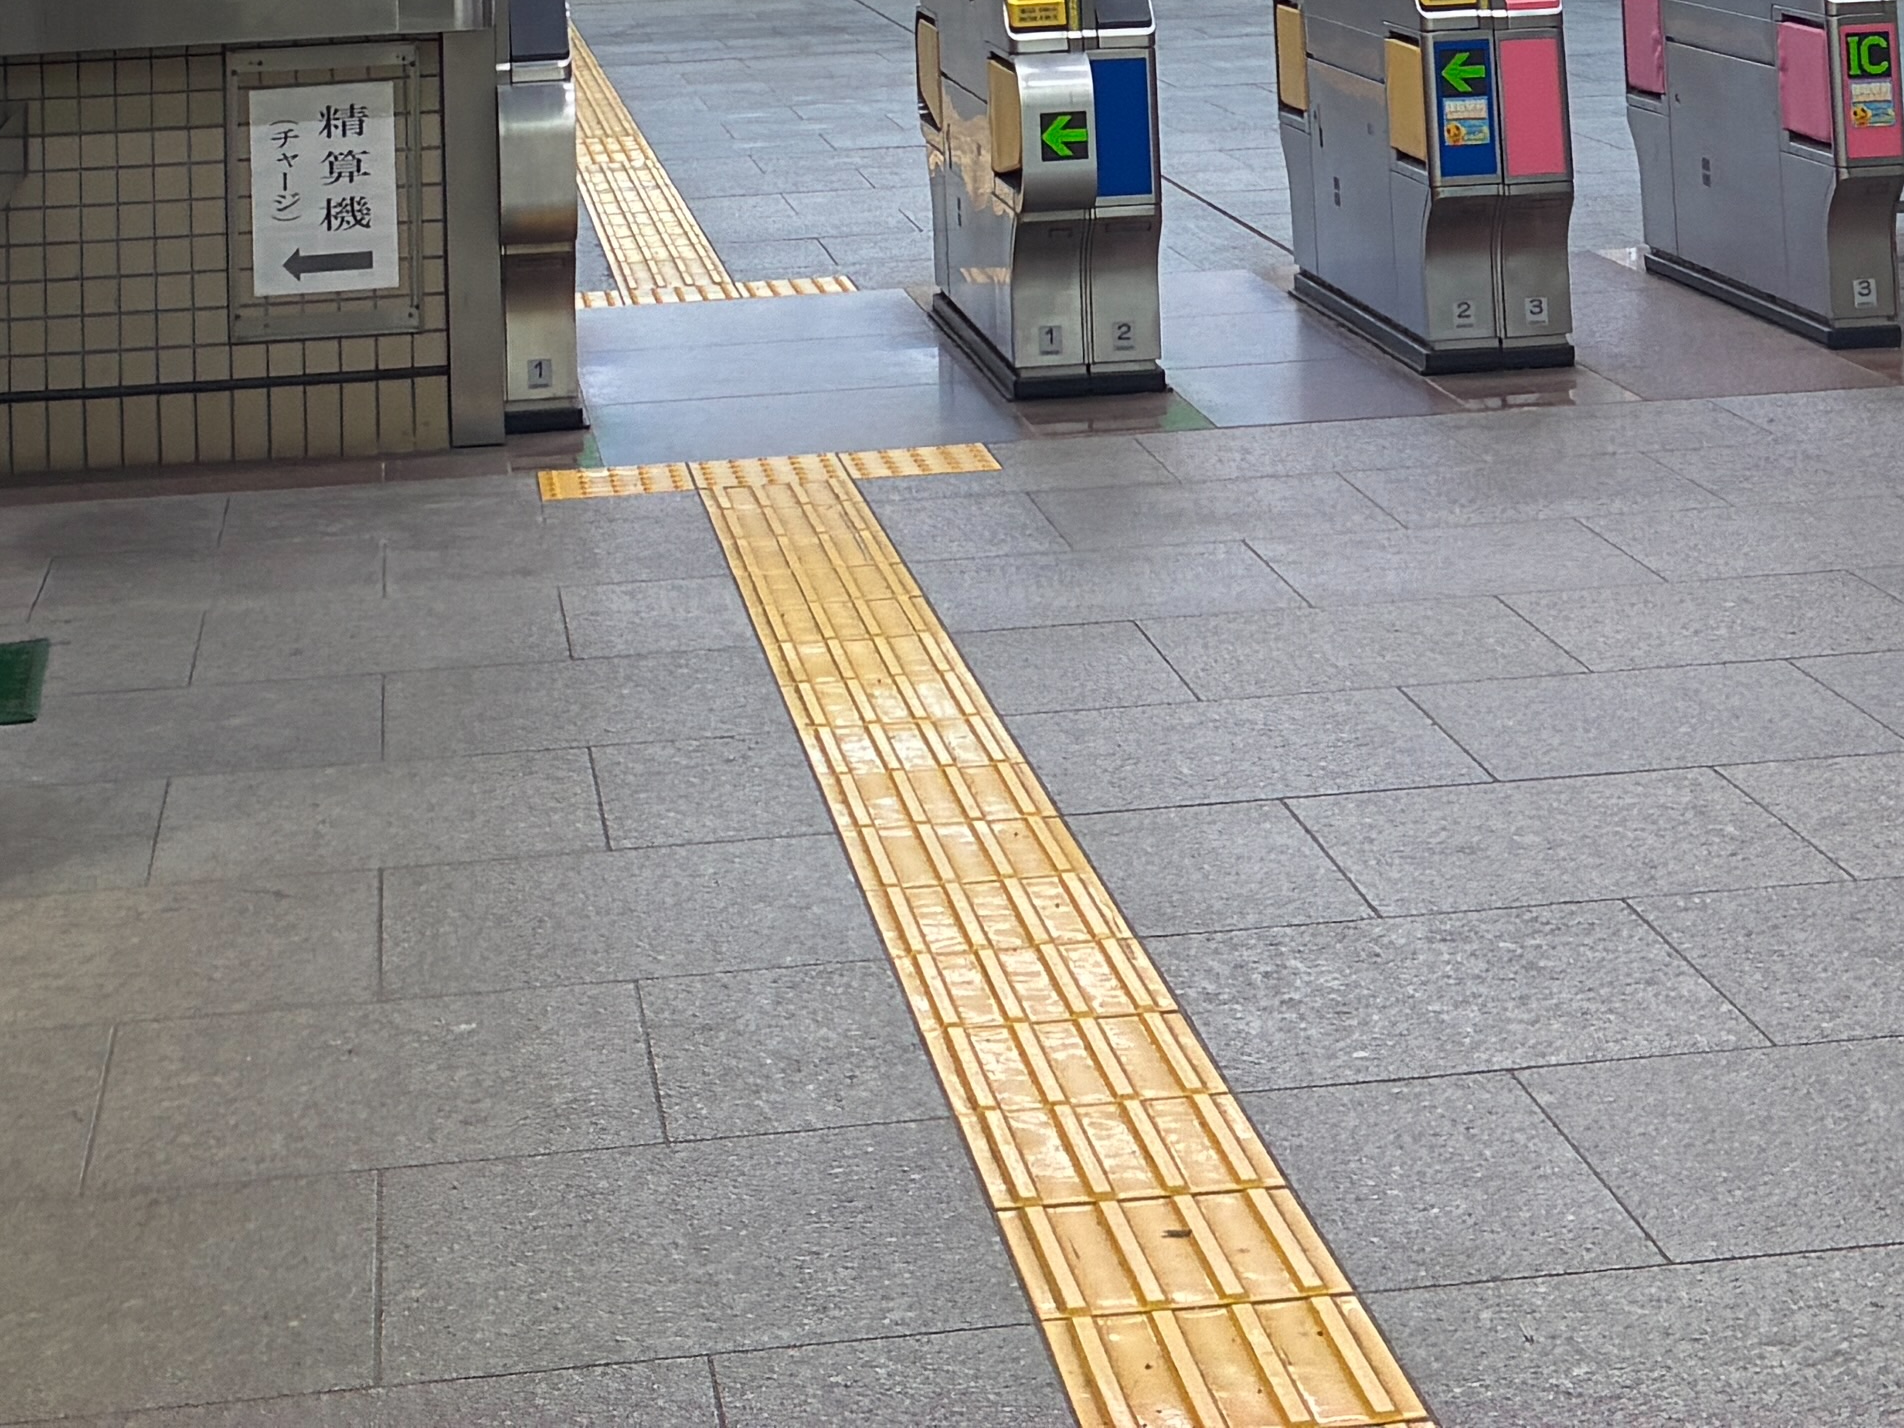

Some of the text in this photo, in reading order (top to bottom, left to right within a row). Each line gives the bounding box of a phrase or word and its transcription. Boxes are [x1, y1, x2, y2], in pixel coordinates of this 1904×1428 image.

[1846, 34, 1890, 75] IC
[317, 101, 373, 233] 精算機
[1856, 278, 1875, 300] 3
[1455, 301, 1472, 322] 2
[1527, 299, 1545, 321] 3
[1044, 326, 1056, 345] 1
[1115, 322, 1132, 342] 2
[533, 359, 547, 379] 1
